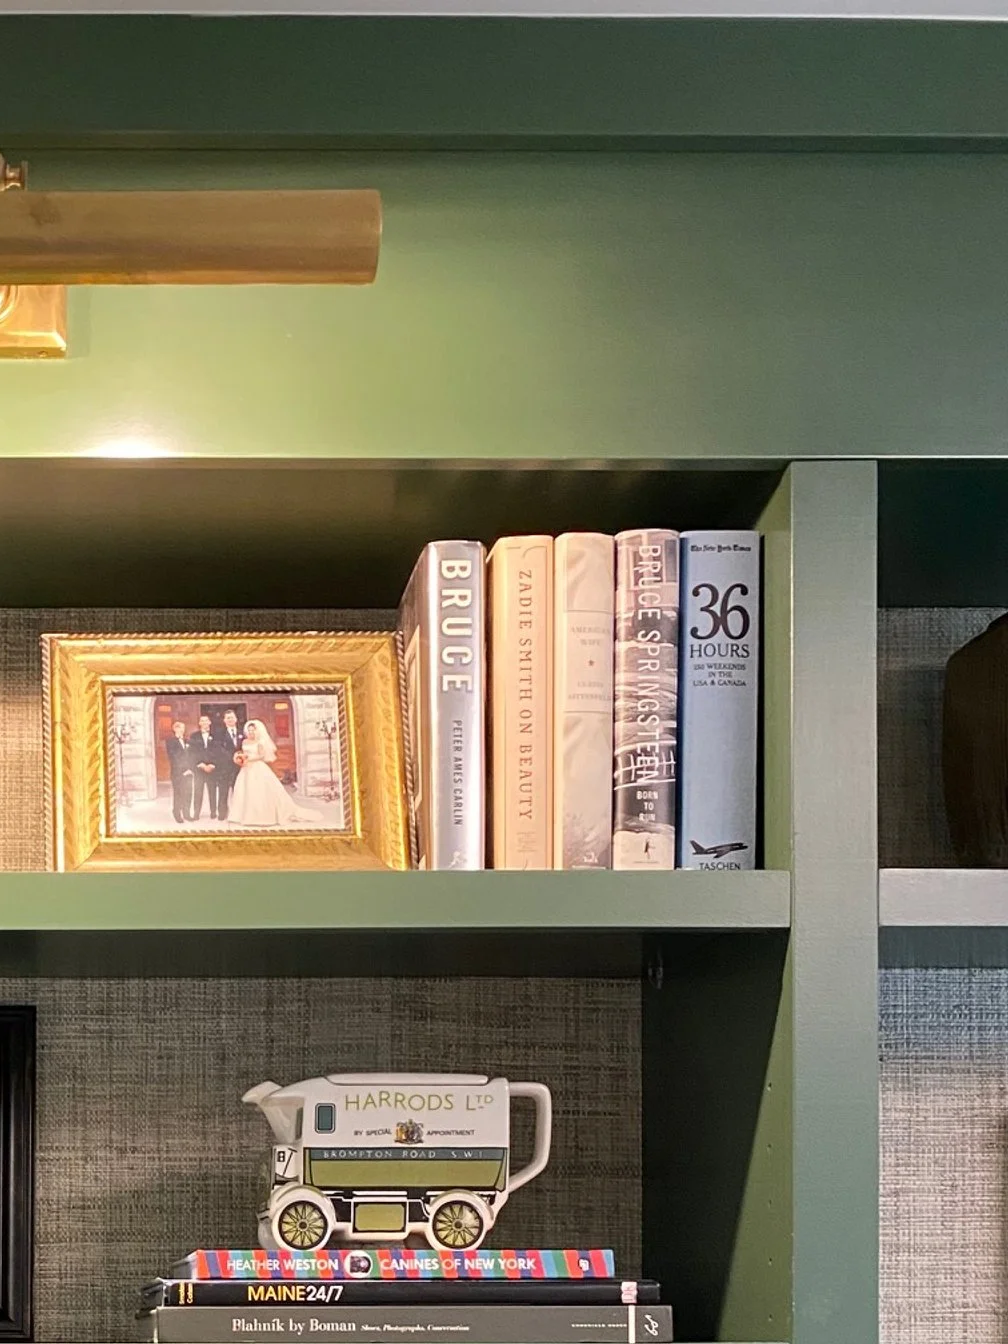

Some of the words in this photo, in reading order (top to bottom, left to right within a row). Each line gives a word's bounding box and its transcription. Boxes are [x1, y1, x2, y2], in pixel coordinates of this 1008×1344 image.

[637, 545, 662, 620] BRUCE
[519, 569, 533, 629] ZADIE
[690, 583, 750, 640] 36
[441, 559, 473, 692] BRUCE
[690, 643, 750, 658] HOURS
[519, 639, 532, 701] SMITH
[636, 630, 662, 782] SPRINGSTEEN
[519, 709, 532, 733] ON
[452, 720, 463, 752] PETER
[452, 757, 463, 784] AMES
[519, 745, 532, 819] BEAUTY
[452, 788, 463, 825] CARLIN
[637, 791, 659, 800] BORN
[644, 802, 654, 810] TO
[345, 1091, 453, 1111] HARRODS
[323, 1150, 392, 1159] BROMPTON
[402, 1151, 436, 1159] ROAD
[227, 1259, 280, 1270] HEATHER
[283, 1259, 339, 1270] WESTON
[381, 1259, 439, 1271] CANINES
[441, 1259, 461, 1271] OF
[464, 1259, 494, 1271] NEW
[497, 1259, 536, 1271] YORK
[232, 1319, 285, 1331] Blahnik
[290, 1319, 305, 1335] by
[310, 1319, 355, 1331] Boman
